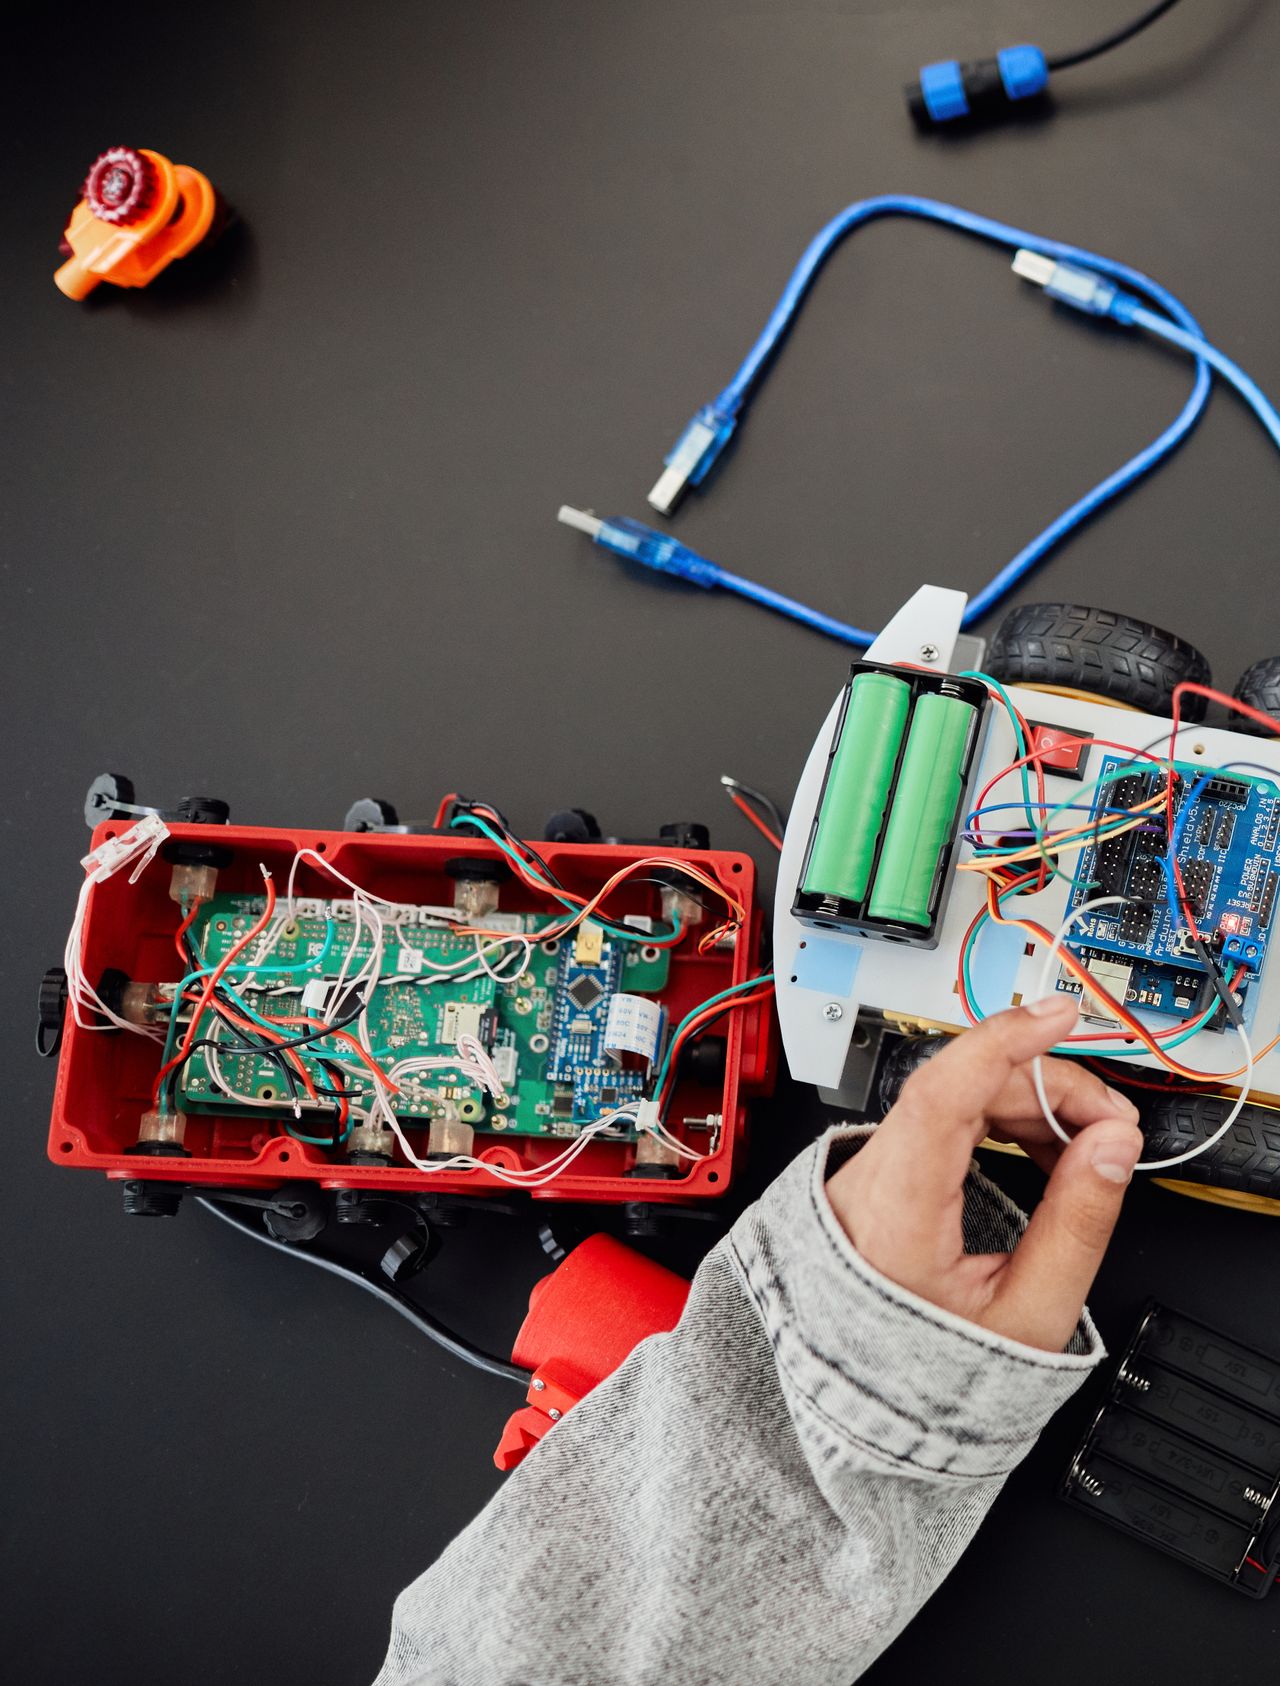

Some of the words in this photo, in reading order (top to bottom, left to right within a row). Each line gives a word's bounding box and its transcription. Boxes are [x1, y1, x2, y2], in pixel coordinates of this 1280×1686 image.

[1249, 812, 1264, 845] ANALOG
[1258, 797, 1267, 808] IN
[1239, 857, 1253, 885] POWER
[1153, 906, 1174, 956] Arduino
[1176, 822, 1194, 864] Shield
[1085, 917, 1097, 937] RoHS
[1165, 928, 1176, 952] RESET
